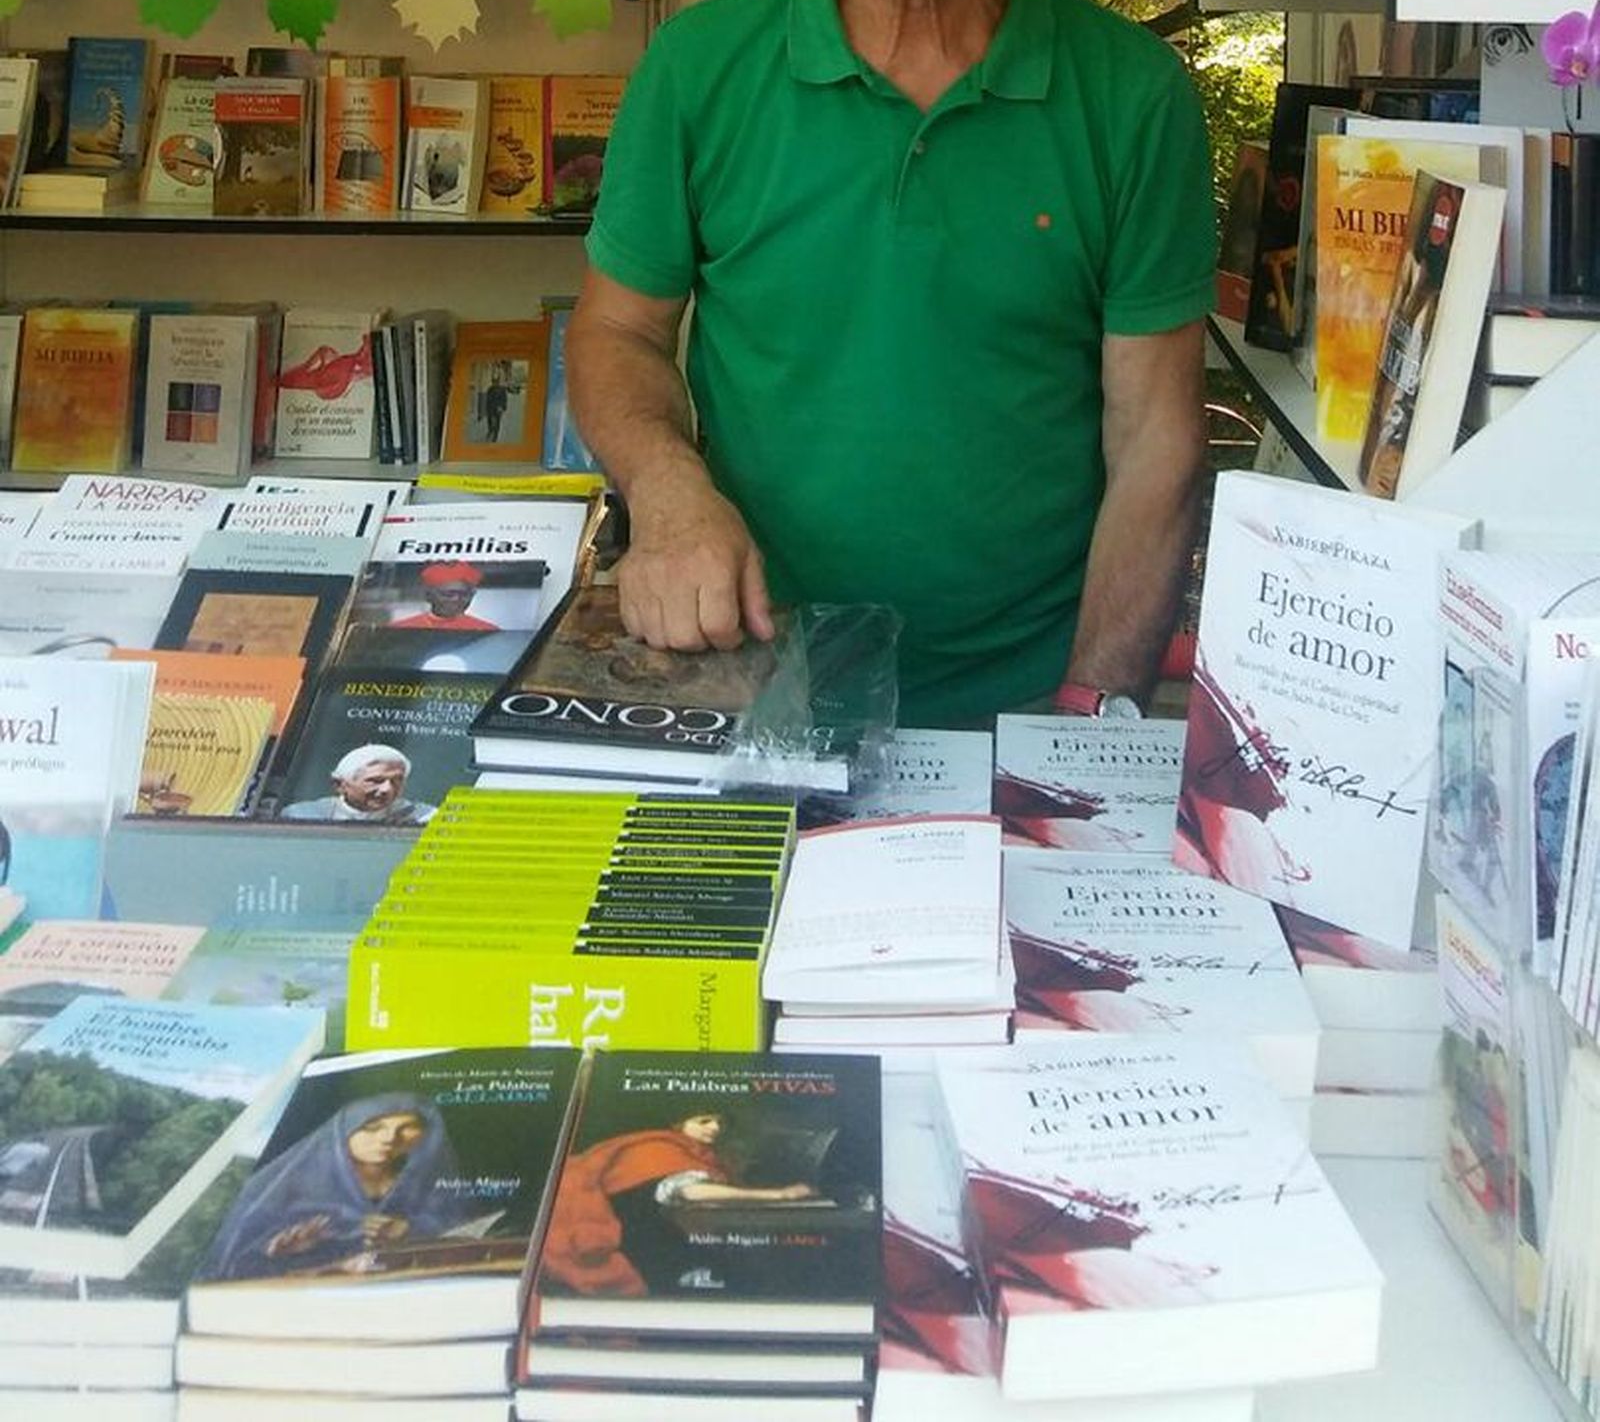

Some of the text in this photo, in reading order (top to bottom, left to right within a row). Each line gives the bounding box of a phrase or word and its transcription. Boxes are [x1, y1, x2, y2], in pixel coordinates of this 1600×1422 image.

[1333, 206, 1365, 234] MI
[83, 480, 207, 506] NARRAR
[397, 537, 529, 555] Familias
[1257, 570, 1395, 638] Ejercicio
[1248, 619, 1396, 682] de amor
[343, 683, 465, 702] BENEDICTO
[1052, 736, 1180, 754] Ejercicio
[1066, 885, 1217, 904] Ejercicio
[1062, 904, 1227, 919] de amor
[456, 1080, 551, 1091] Las Palabras
[623, 1078, 837, 1094] Las Palabras VIVAS
[1027, 1079, 1209, 1111] Ejercicio
[1028, 1104, 1224, 1134] de amor
